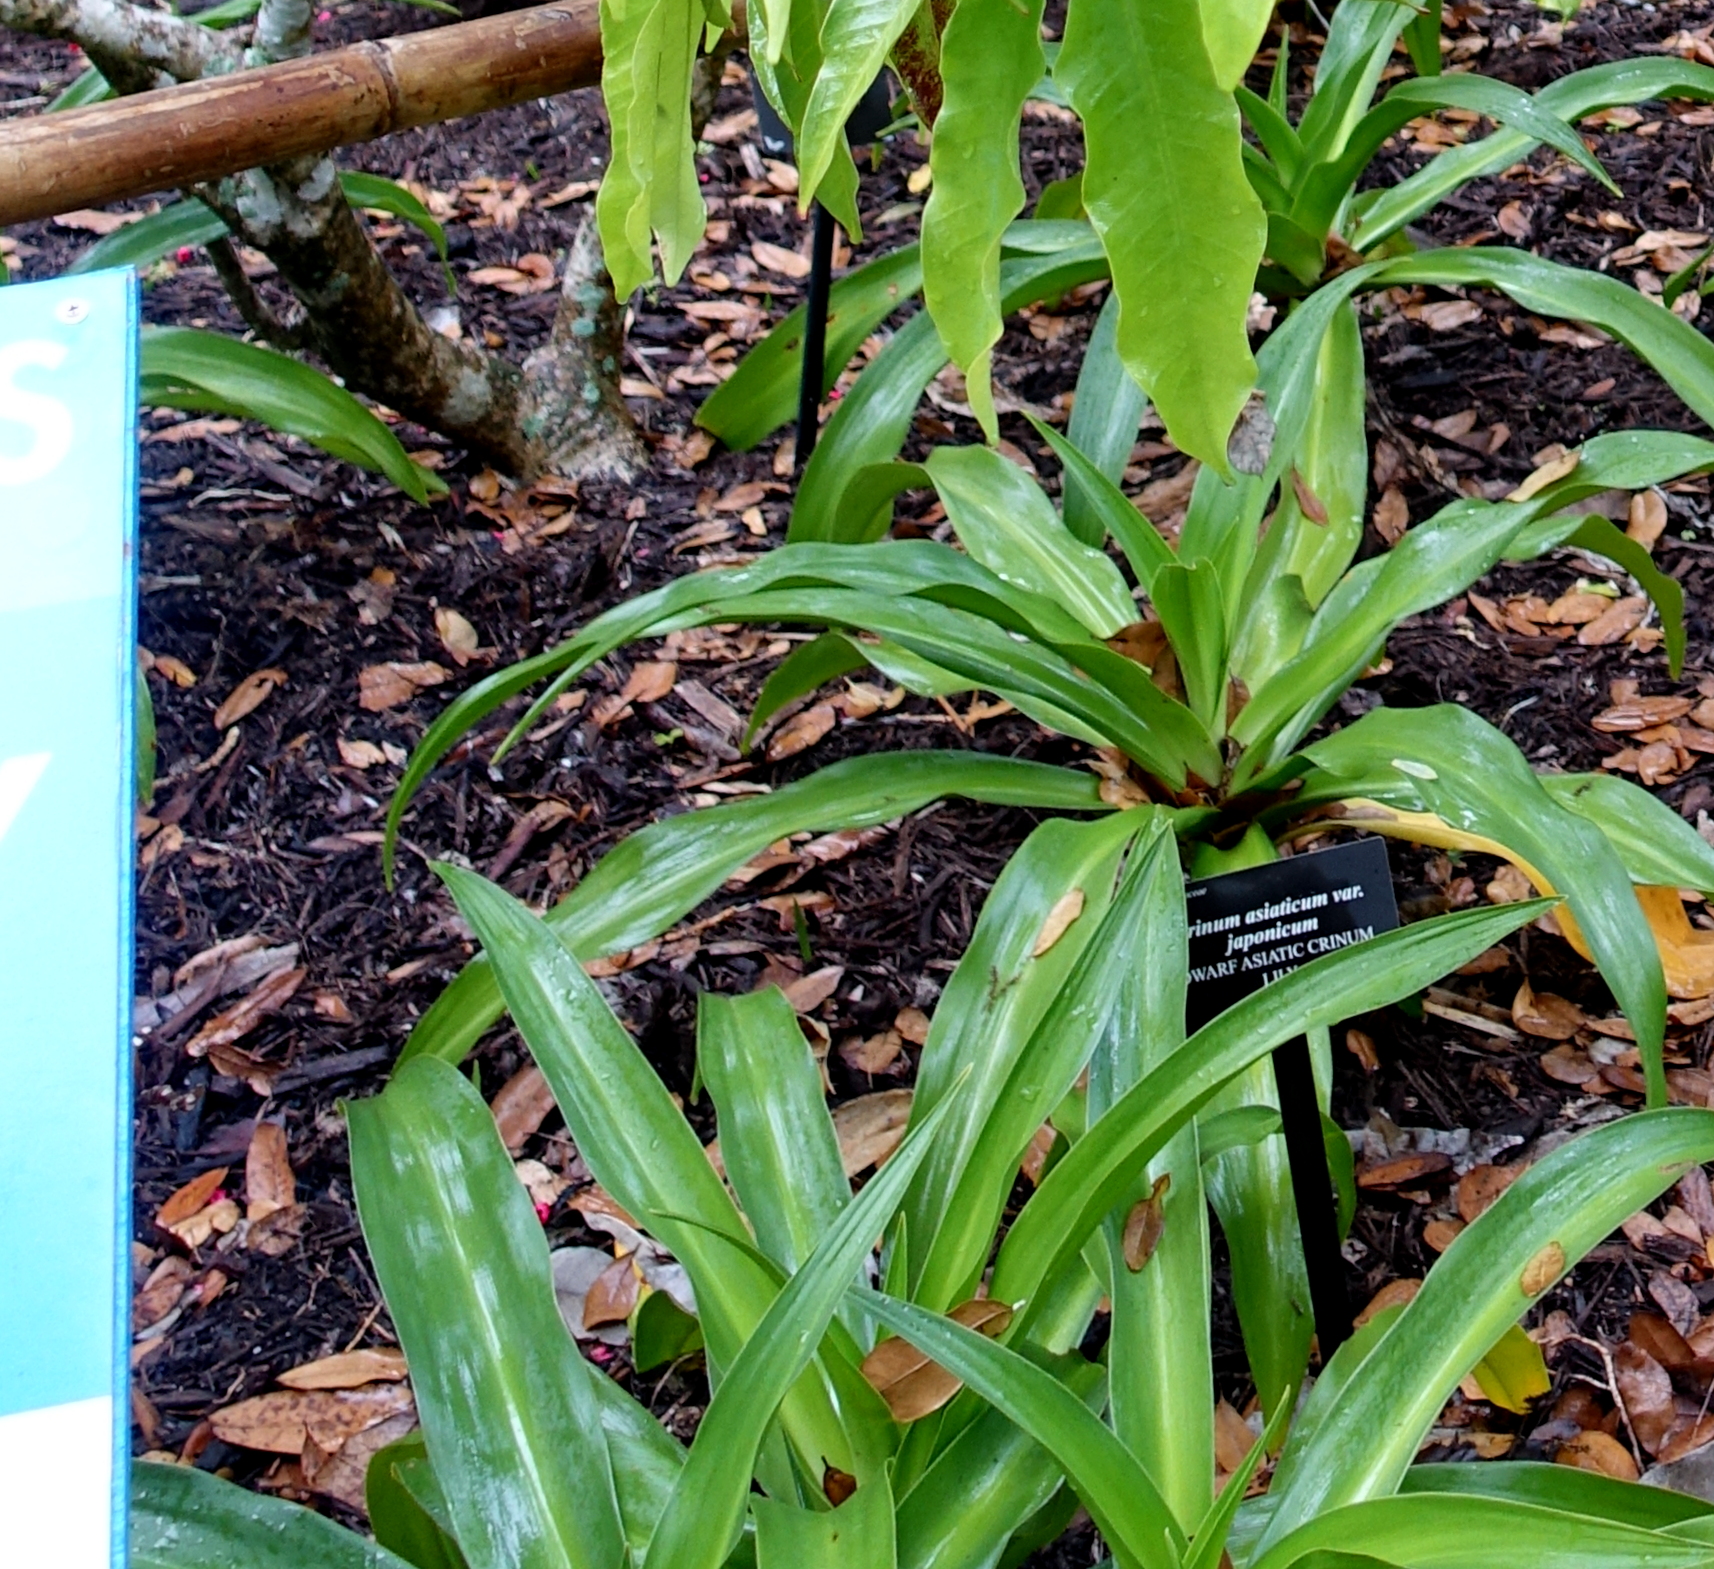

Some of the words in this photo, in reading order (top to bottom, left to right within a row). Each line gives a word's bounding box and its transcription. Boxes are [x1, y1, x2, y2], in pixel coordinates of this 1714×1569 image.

[1188, 919, 1241, 939] rinum
[1244, 896, 1328, 925] asiaticum
[1332, 885, 1364, 903] var.
[1224, 917, 1318, 957] japonicum
[1241, 942, 1305, 971] ASIATIC
[1307, 925, 1375, 954] CRINUM
